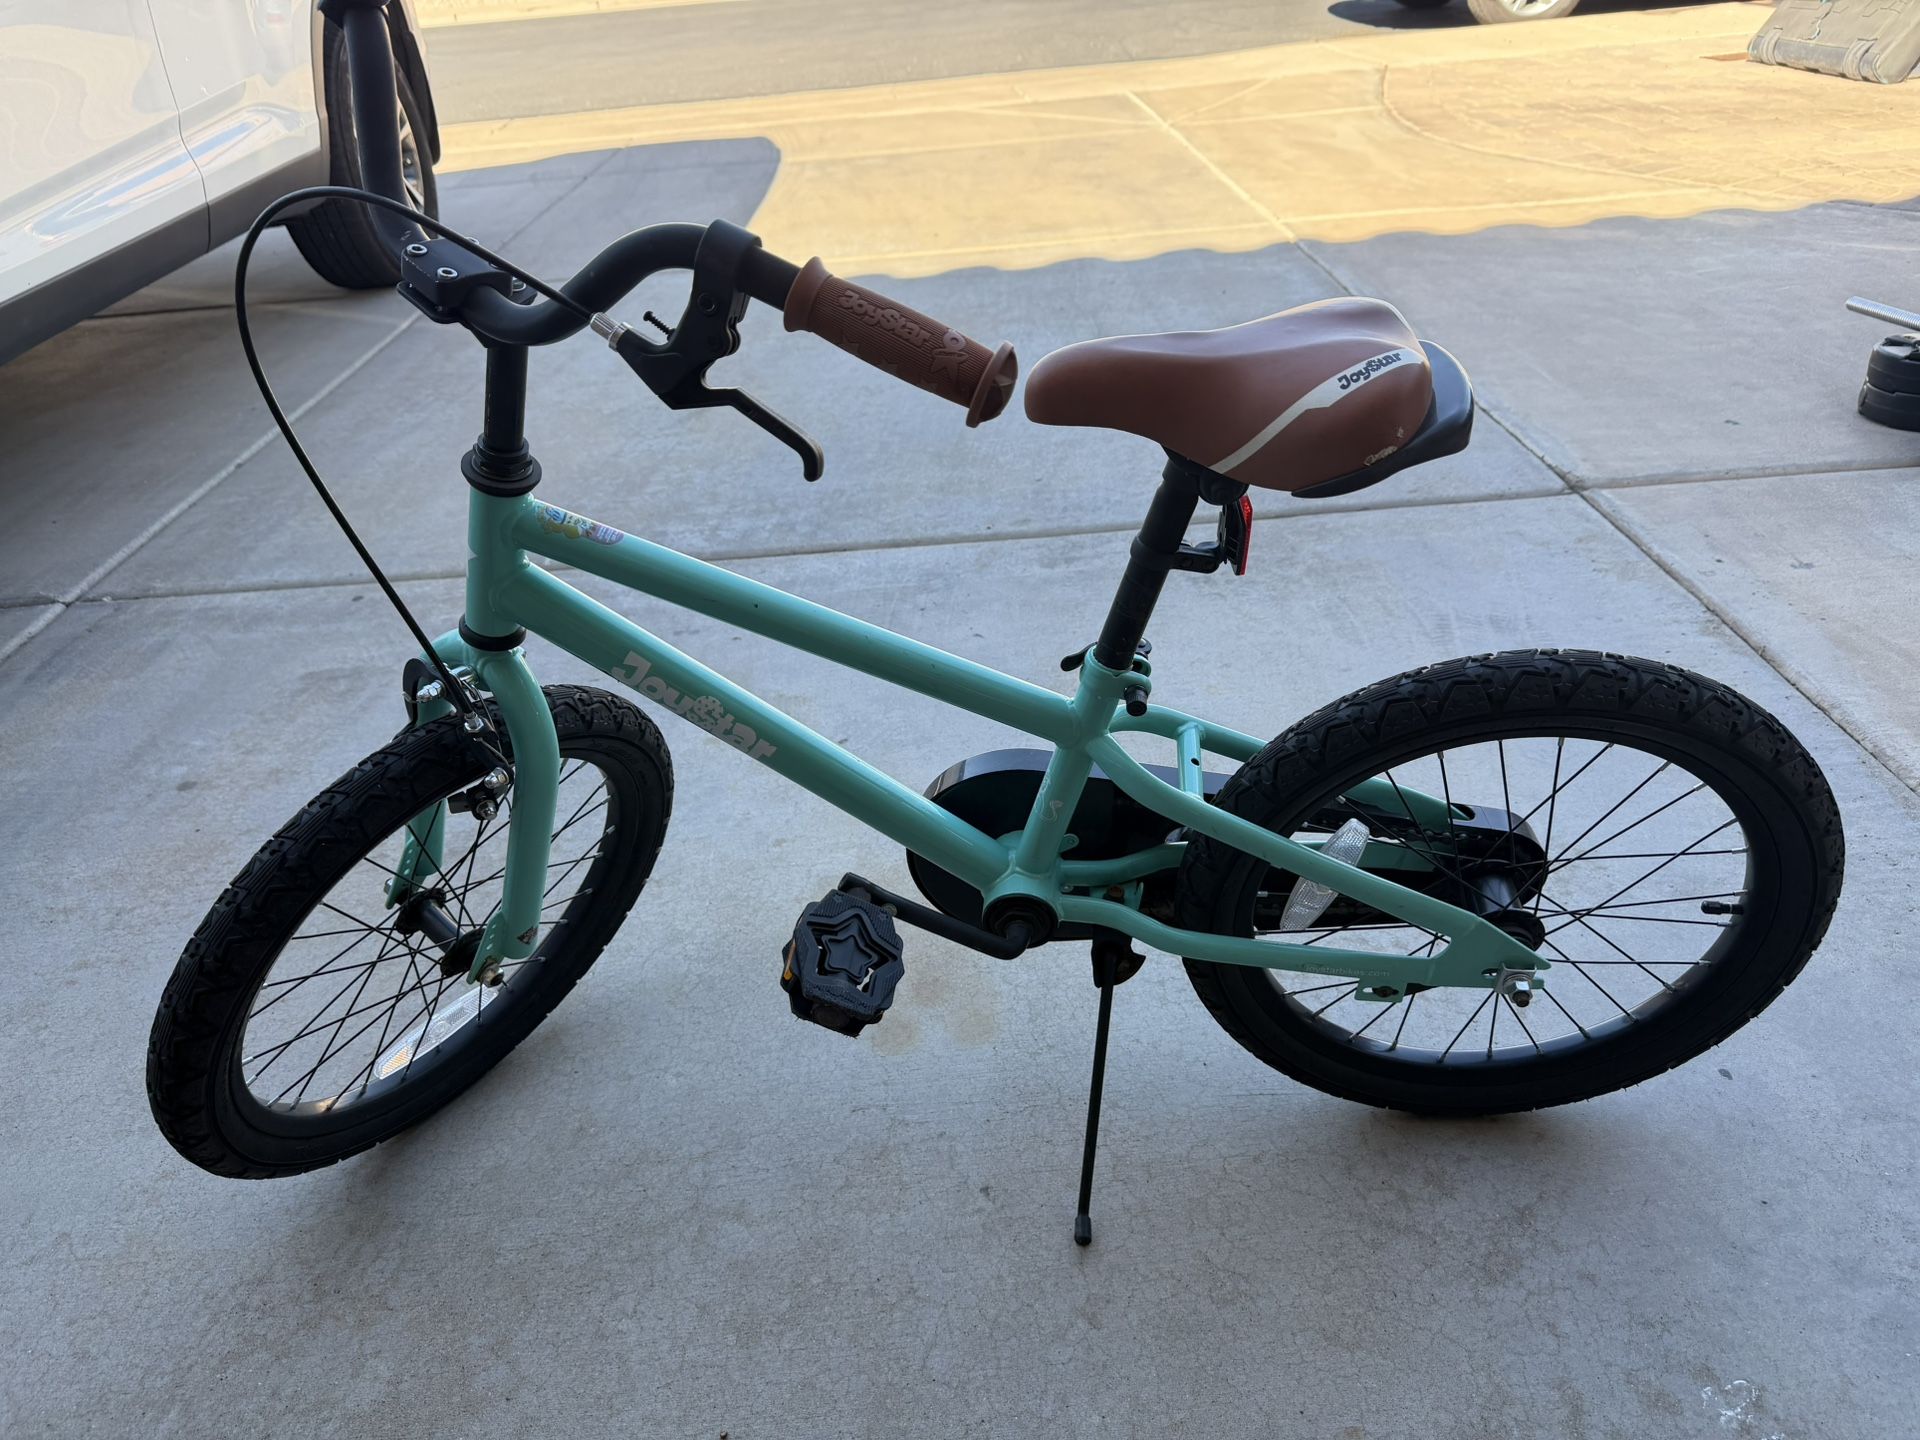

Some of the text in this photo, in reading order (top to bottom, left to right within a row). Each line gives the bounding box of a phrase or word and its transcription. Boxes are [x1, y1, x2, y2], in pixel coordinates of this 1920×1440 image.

[838, 290, 932, 346] JoyStar
[1337, 352, 1402, 390] JoyStar
[611, 650, 778, 759] JoyStar
